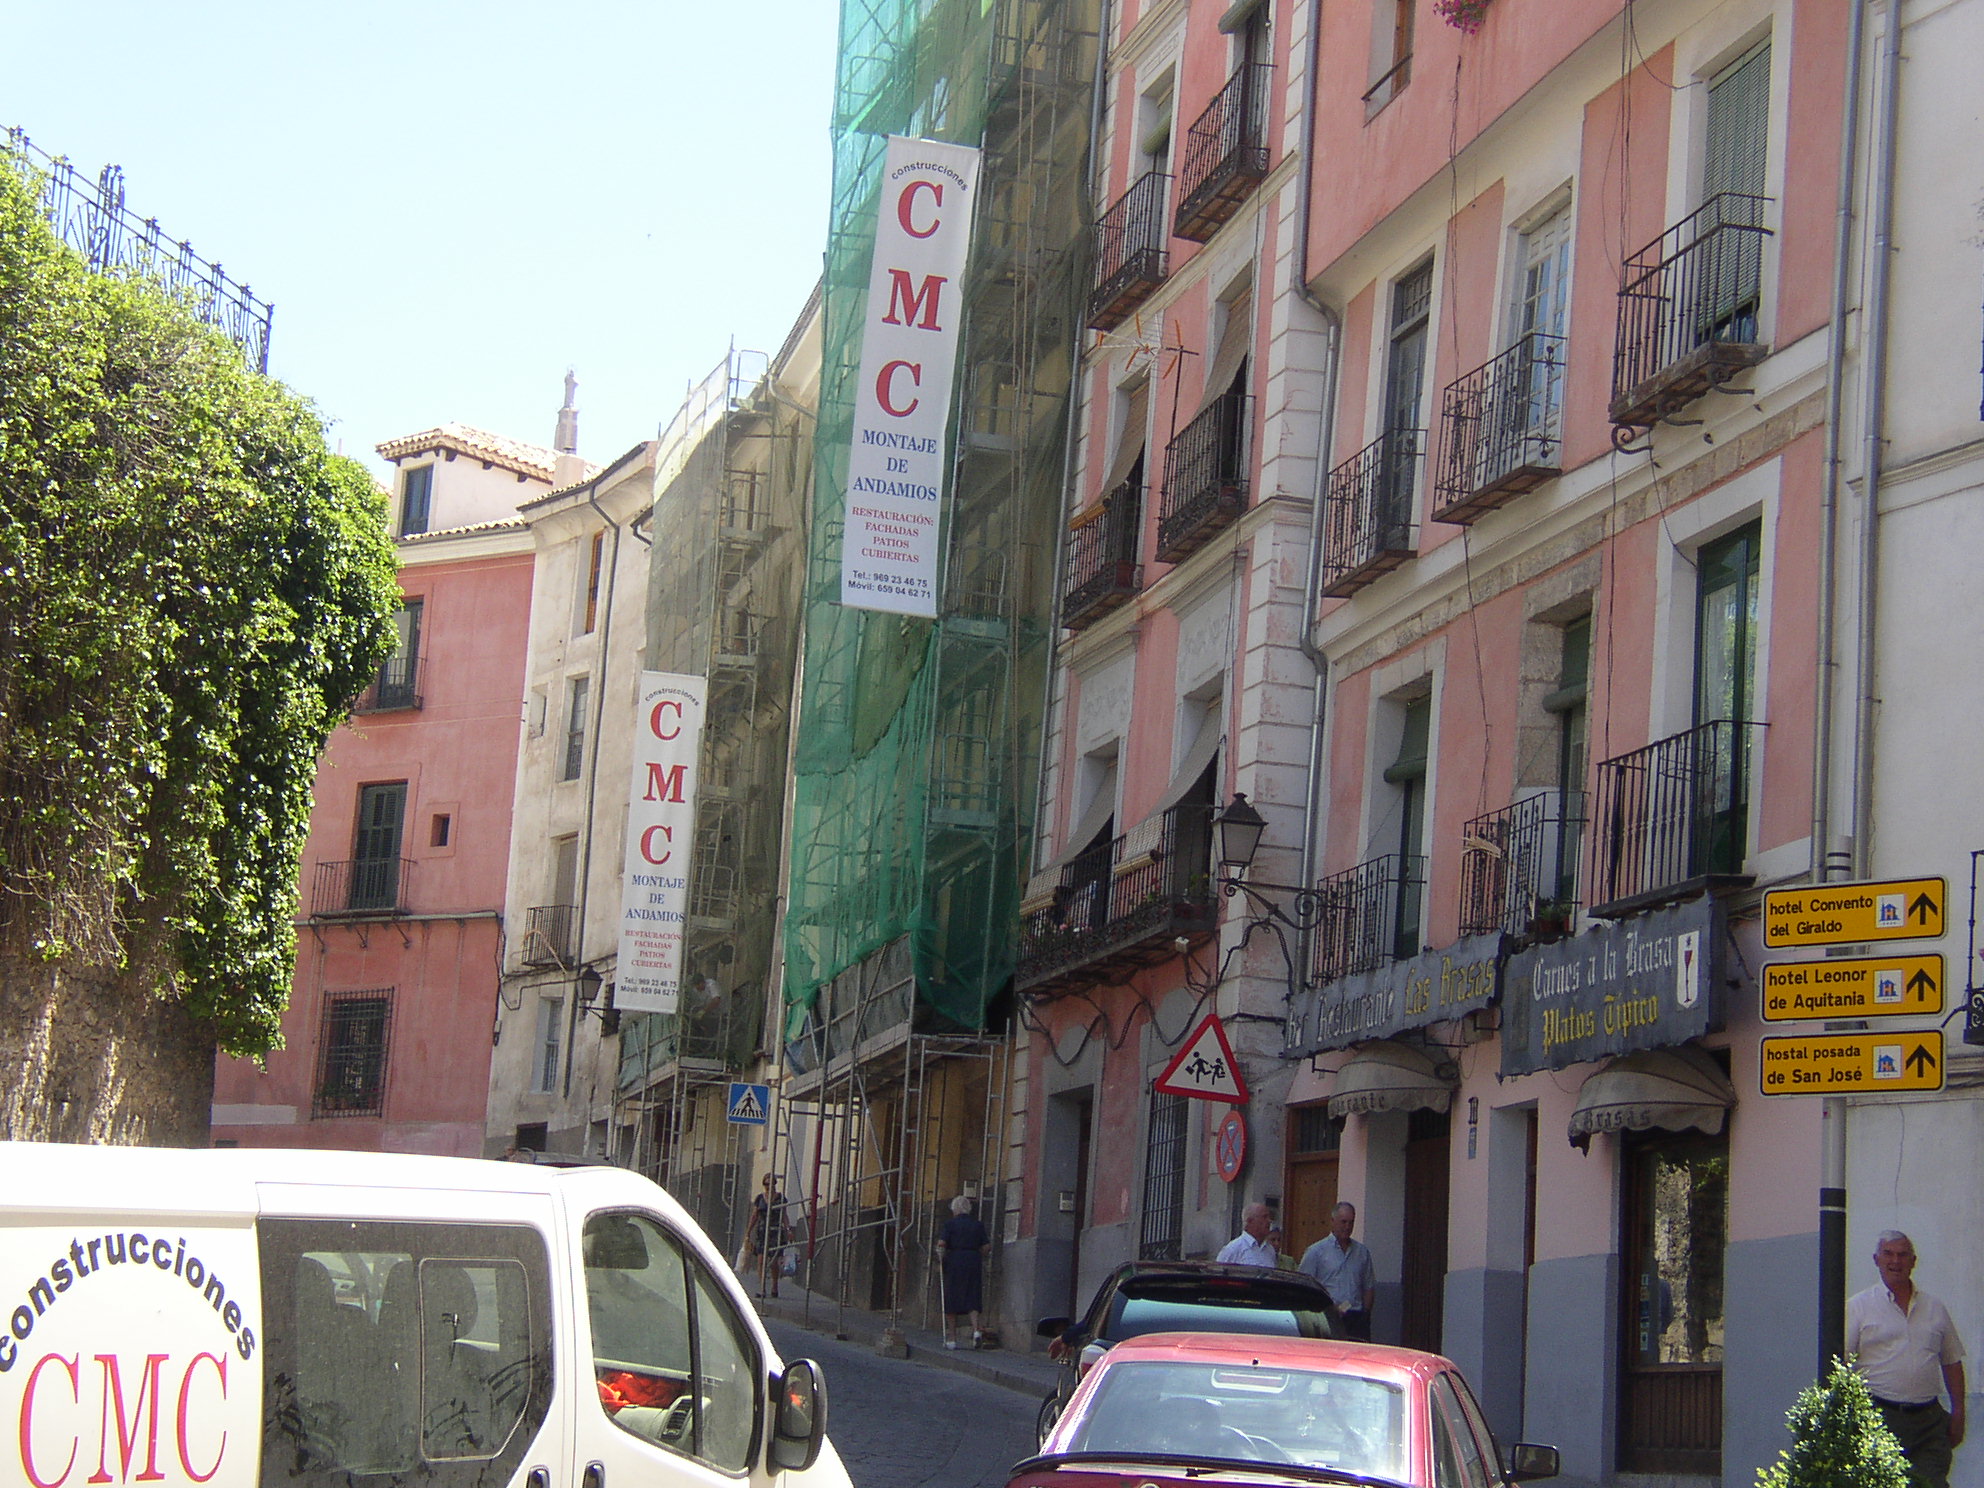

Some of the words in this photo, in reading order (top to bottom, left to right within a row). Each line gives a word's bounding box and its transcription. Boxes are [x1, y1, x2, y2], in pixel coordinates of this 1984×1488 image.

[892, 161, 968, 192] construcciones
[862, 429, 937, 454] MONTAJE
[886, 457, 909, 474] DE
[853, 476, 937, 501] ANDAMIOS
[865, 521, 919, 537] FACHADAS
[873, 536, 910, 549] PATIOS
[861, 547, 919, 563] CUBIERTAS
[917, 579, 928, 588] 75
[921, 590, 931, 599] 71
[645, 687, 700, 707] construcciones
[632, 874, 685, 889] MONTAJE
[648, 893, 665, 904] DE
[1770, 900, 1803, 916] hotel
[1810, 895, 1873, 912] Convento
[625, 908, 685, 923] ANDAMIOS
[1770, 923, 1789, 937] del
[1797, 920, 1842, 935] Giraldo
[1533, 958, 1580, 1001] Carnes
[1587, 954, 1596, 987] a
[1602, 940, 1617, 981] la
[1625, 930, 1673, 977] Brasa
[1769, 970, 1808, 986] hotel
[1814, 968, 1867, 984] Leonor
[1769, 995, 1787, 1010] de
[1794, 991, 1865, 1011] Aquitania
[1543, 1006, 1595, 1055] Platos
[1767, 1046, 1808, 1061] hostal
[1813, 1045, 1861, 1062] posada
[1767, 1071, 1785, 1085] de
[1792, 1068, 1821, 1084] San
[1828, 1066, 1863, 1082] José
[0, 1233, 255, 1373] construcciones
[19, 1352, 228, 1488] CMC
